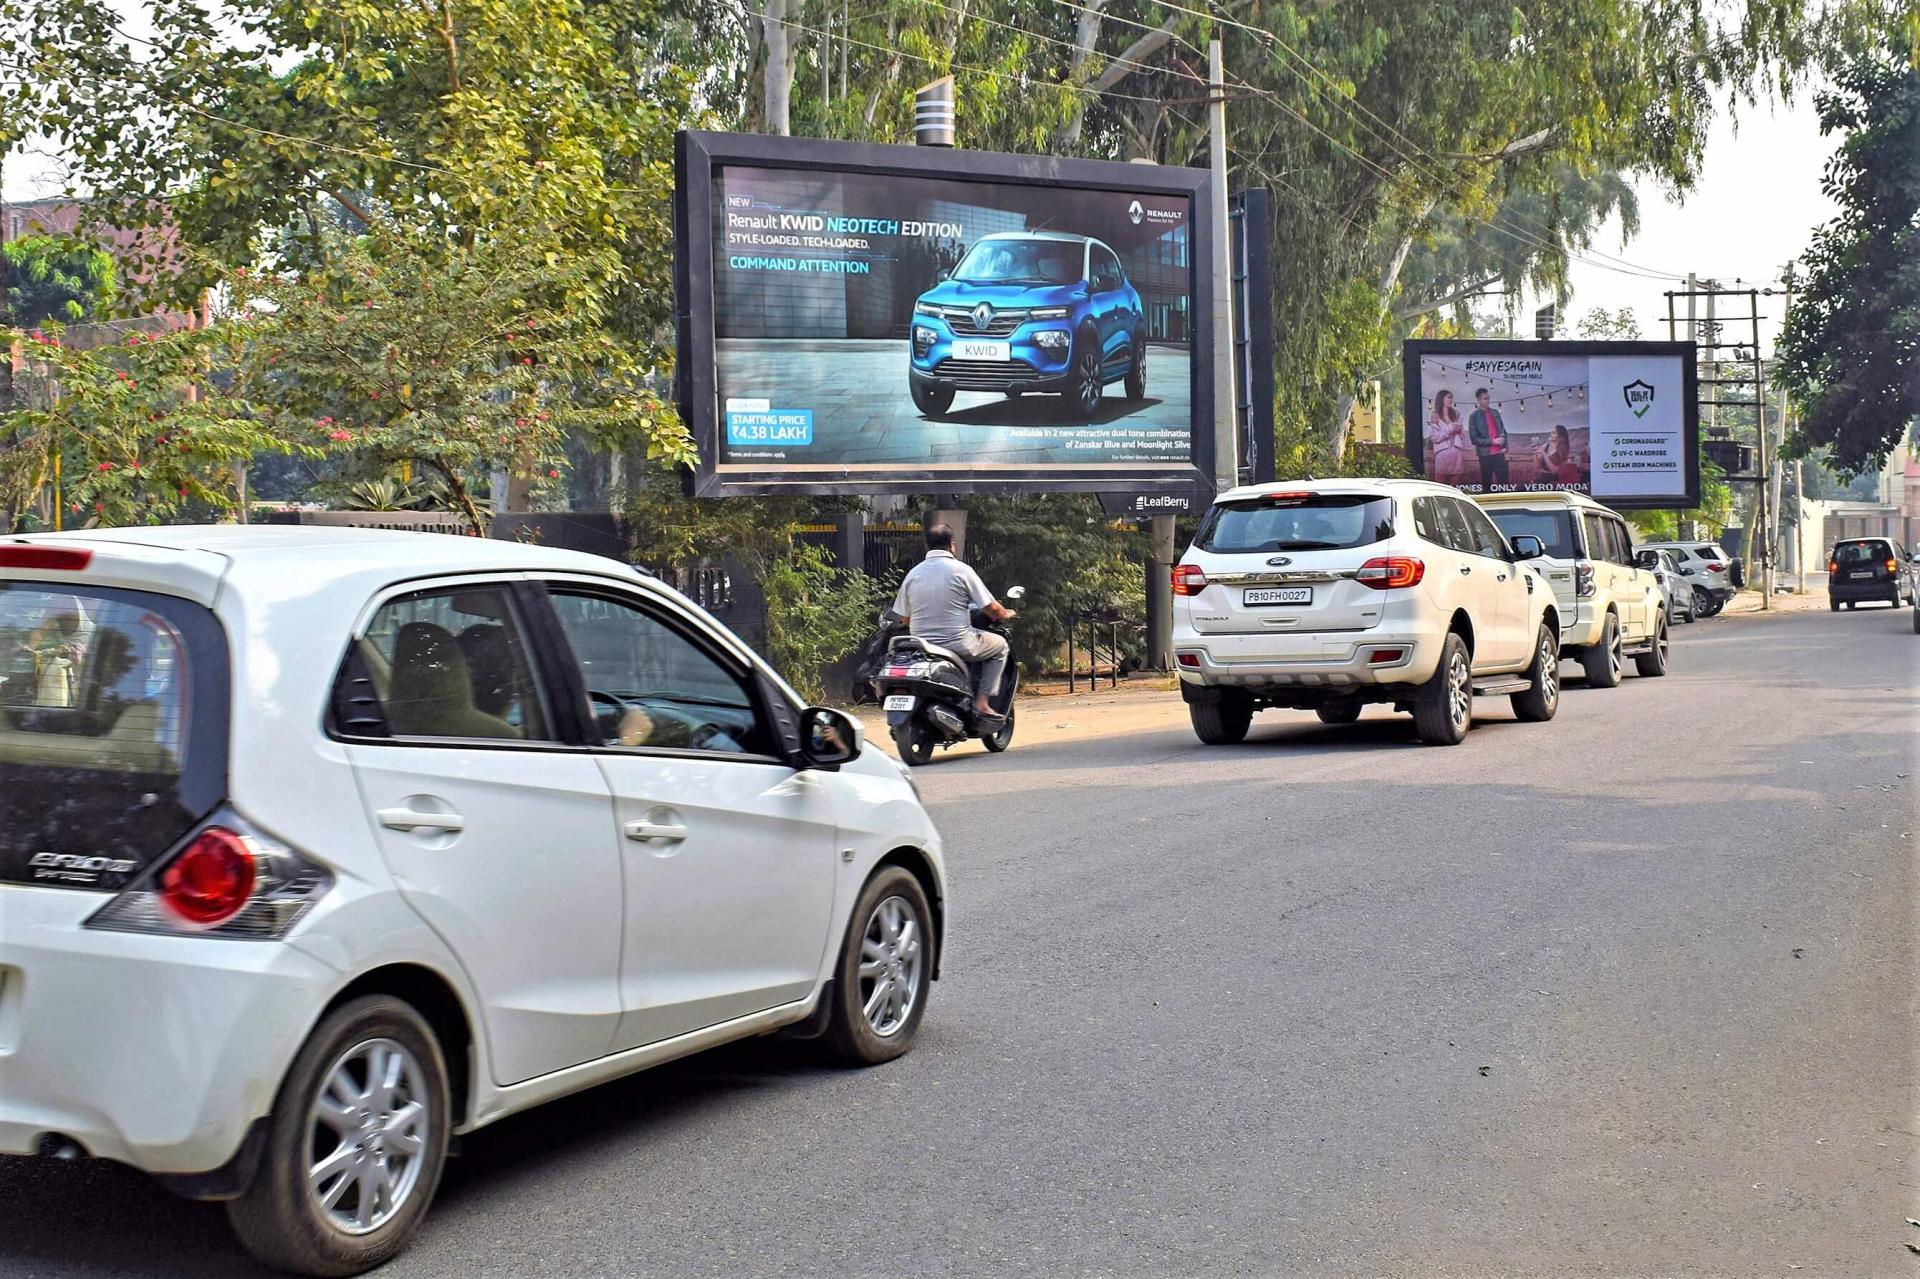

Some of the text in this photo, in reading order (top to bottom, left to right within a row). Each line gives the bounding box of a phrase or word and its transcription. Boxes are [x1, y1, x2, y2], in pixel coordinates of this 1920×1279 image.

[728, 197, 750, 207] NEW
[1147, 210, 1182, 218] RENAULT
[728, 213, 962, 238] Renault KWID NEOTECH EDITION
[729, 233, 870, 249] STYLE-LOADED. TECH-LOADED.
[730, 256, 869, 273] COMMAND ATTENTION
[965, 345, 998, 356] KWID
[1465, 360, 1542, 372] #SAYYESAGAIN
[732, 415, 806, 425] STARTING PRICE
[1010, 429, 1043, 437] Available
[1076, 429, 1110, 437] attractive
[1111, 429, 1128, 437] dual
[1129, 429, 1146, 437] tone
[1065, 440, 1073, 448] of
[1137, 441, 1173, 450] Moonlight
[1490, 484, 1517, 492] ONLY
[1524, 483, 1554, 492] VERO
[1555, 483, 1588, 491] MODA
[1143, 496, 1189, 509] LeafBerry
[1249, 591, 1306, 601] PB10FH0027
